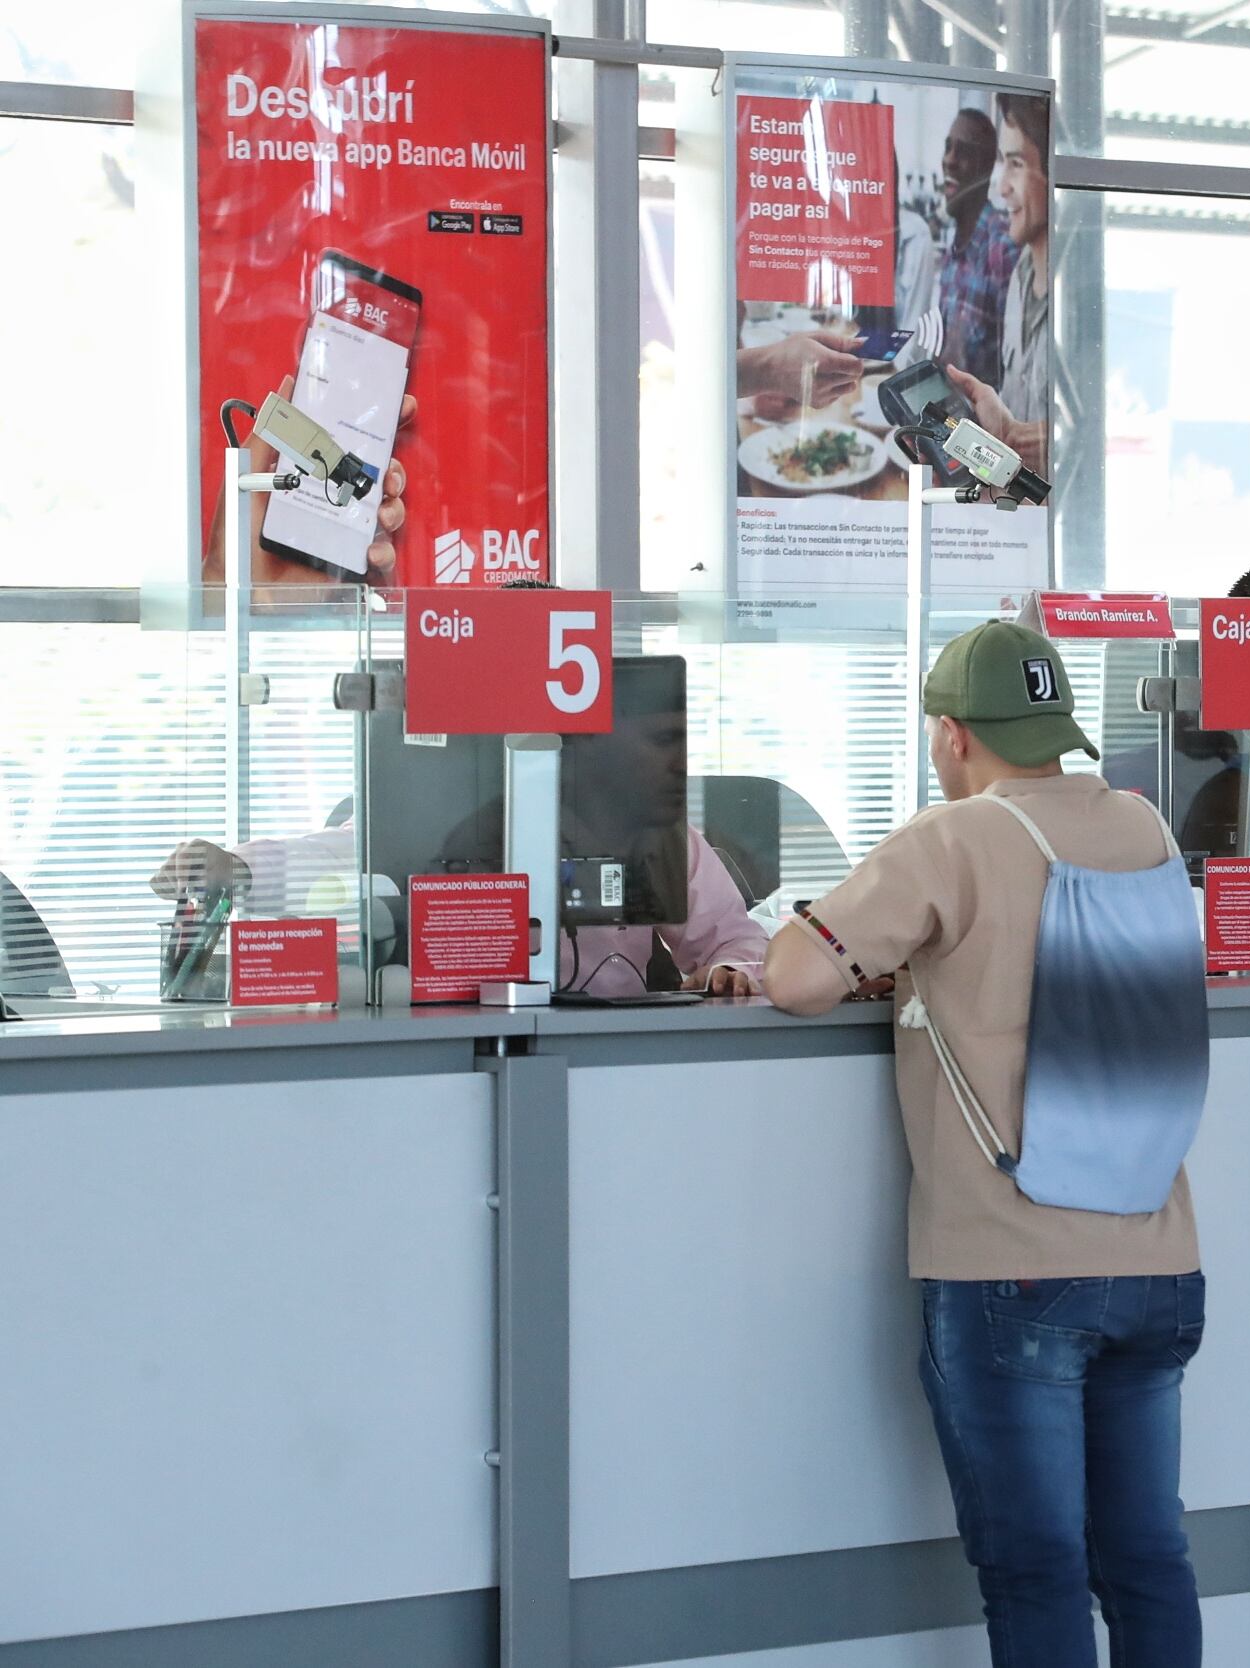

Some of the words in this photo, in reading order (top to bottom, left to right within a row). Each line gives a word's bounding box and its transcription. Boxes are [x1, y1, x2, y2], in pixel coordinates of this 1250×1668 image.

[750, 115, 811, 136] Estam
[227, 130, 251, 160] la
[258, 138, 339, 162] nueva
[345, 141, 392, 170] app
[397, 138, 466, 168] Banca
[471, 142, 526, 171] Móvil
[749, 147, 823, 166] seguro
[825, 151, 857, 169] que
[749, 172, 768, 188] te
[772, 176, 793, 190] va
[796, 177, 807, 191] a
[811, 178, 885, 195] ecantar
[449, 199, 492, 211] Encontrala
[492, 203, 503, 211] en
[749, 201, 802, 221] pagar
[441, 220, 460, 231] Google
[460, 221, 472, 231] Play
[492, 223, 504, 233] App
[504, 224, 520, 233] Store
[749, 231, 779, 243] Porque
[780, 234, 797, 242] con
[798, 233, 806, 243] la
[850, 236, 862, 246] de
[863, 237, 883, 248] Pago
[748, 245, 763, 254] Sin
[764, 245, 804, 256] Contacto
[855, 251, 871, 260] son
[847, 265, 879, 275] seguras
[364, 302, 389, 325] BAC
[774, 522, 787, 530] Las
[788, 535, 797, 543] Ya
[797, 536, 808, 544] no
[483, 529, 540, 570] BAC
[782, 548, 802, 556] Cada
[1055, 607, 1100, 622] Brandon
[1100, 608, 1145, 622] Ramírez
[1146, 609, 1159, 623] A.
[419, 608, 474, 644] Caja
[545, 610, 600, 714] 5
[1206, 865, 1248, 874] COMUNICADO
[412, 881, 463, 892] COMUNICADO
[463, 880, 494, 890] PÚBLICO
[494, 880, 527, 890] GENERAL
[238, 929, 267, 940] Horario
[267, 931, 285, 940] para
[285, 928, 323, 939] recepción
[238, 942, 248, 952] de
[249, 941, 284, 951] monedas
